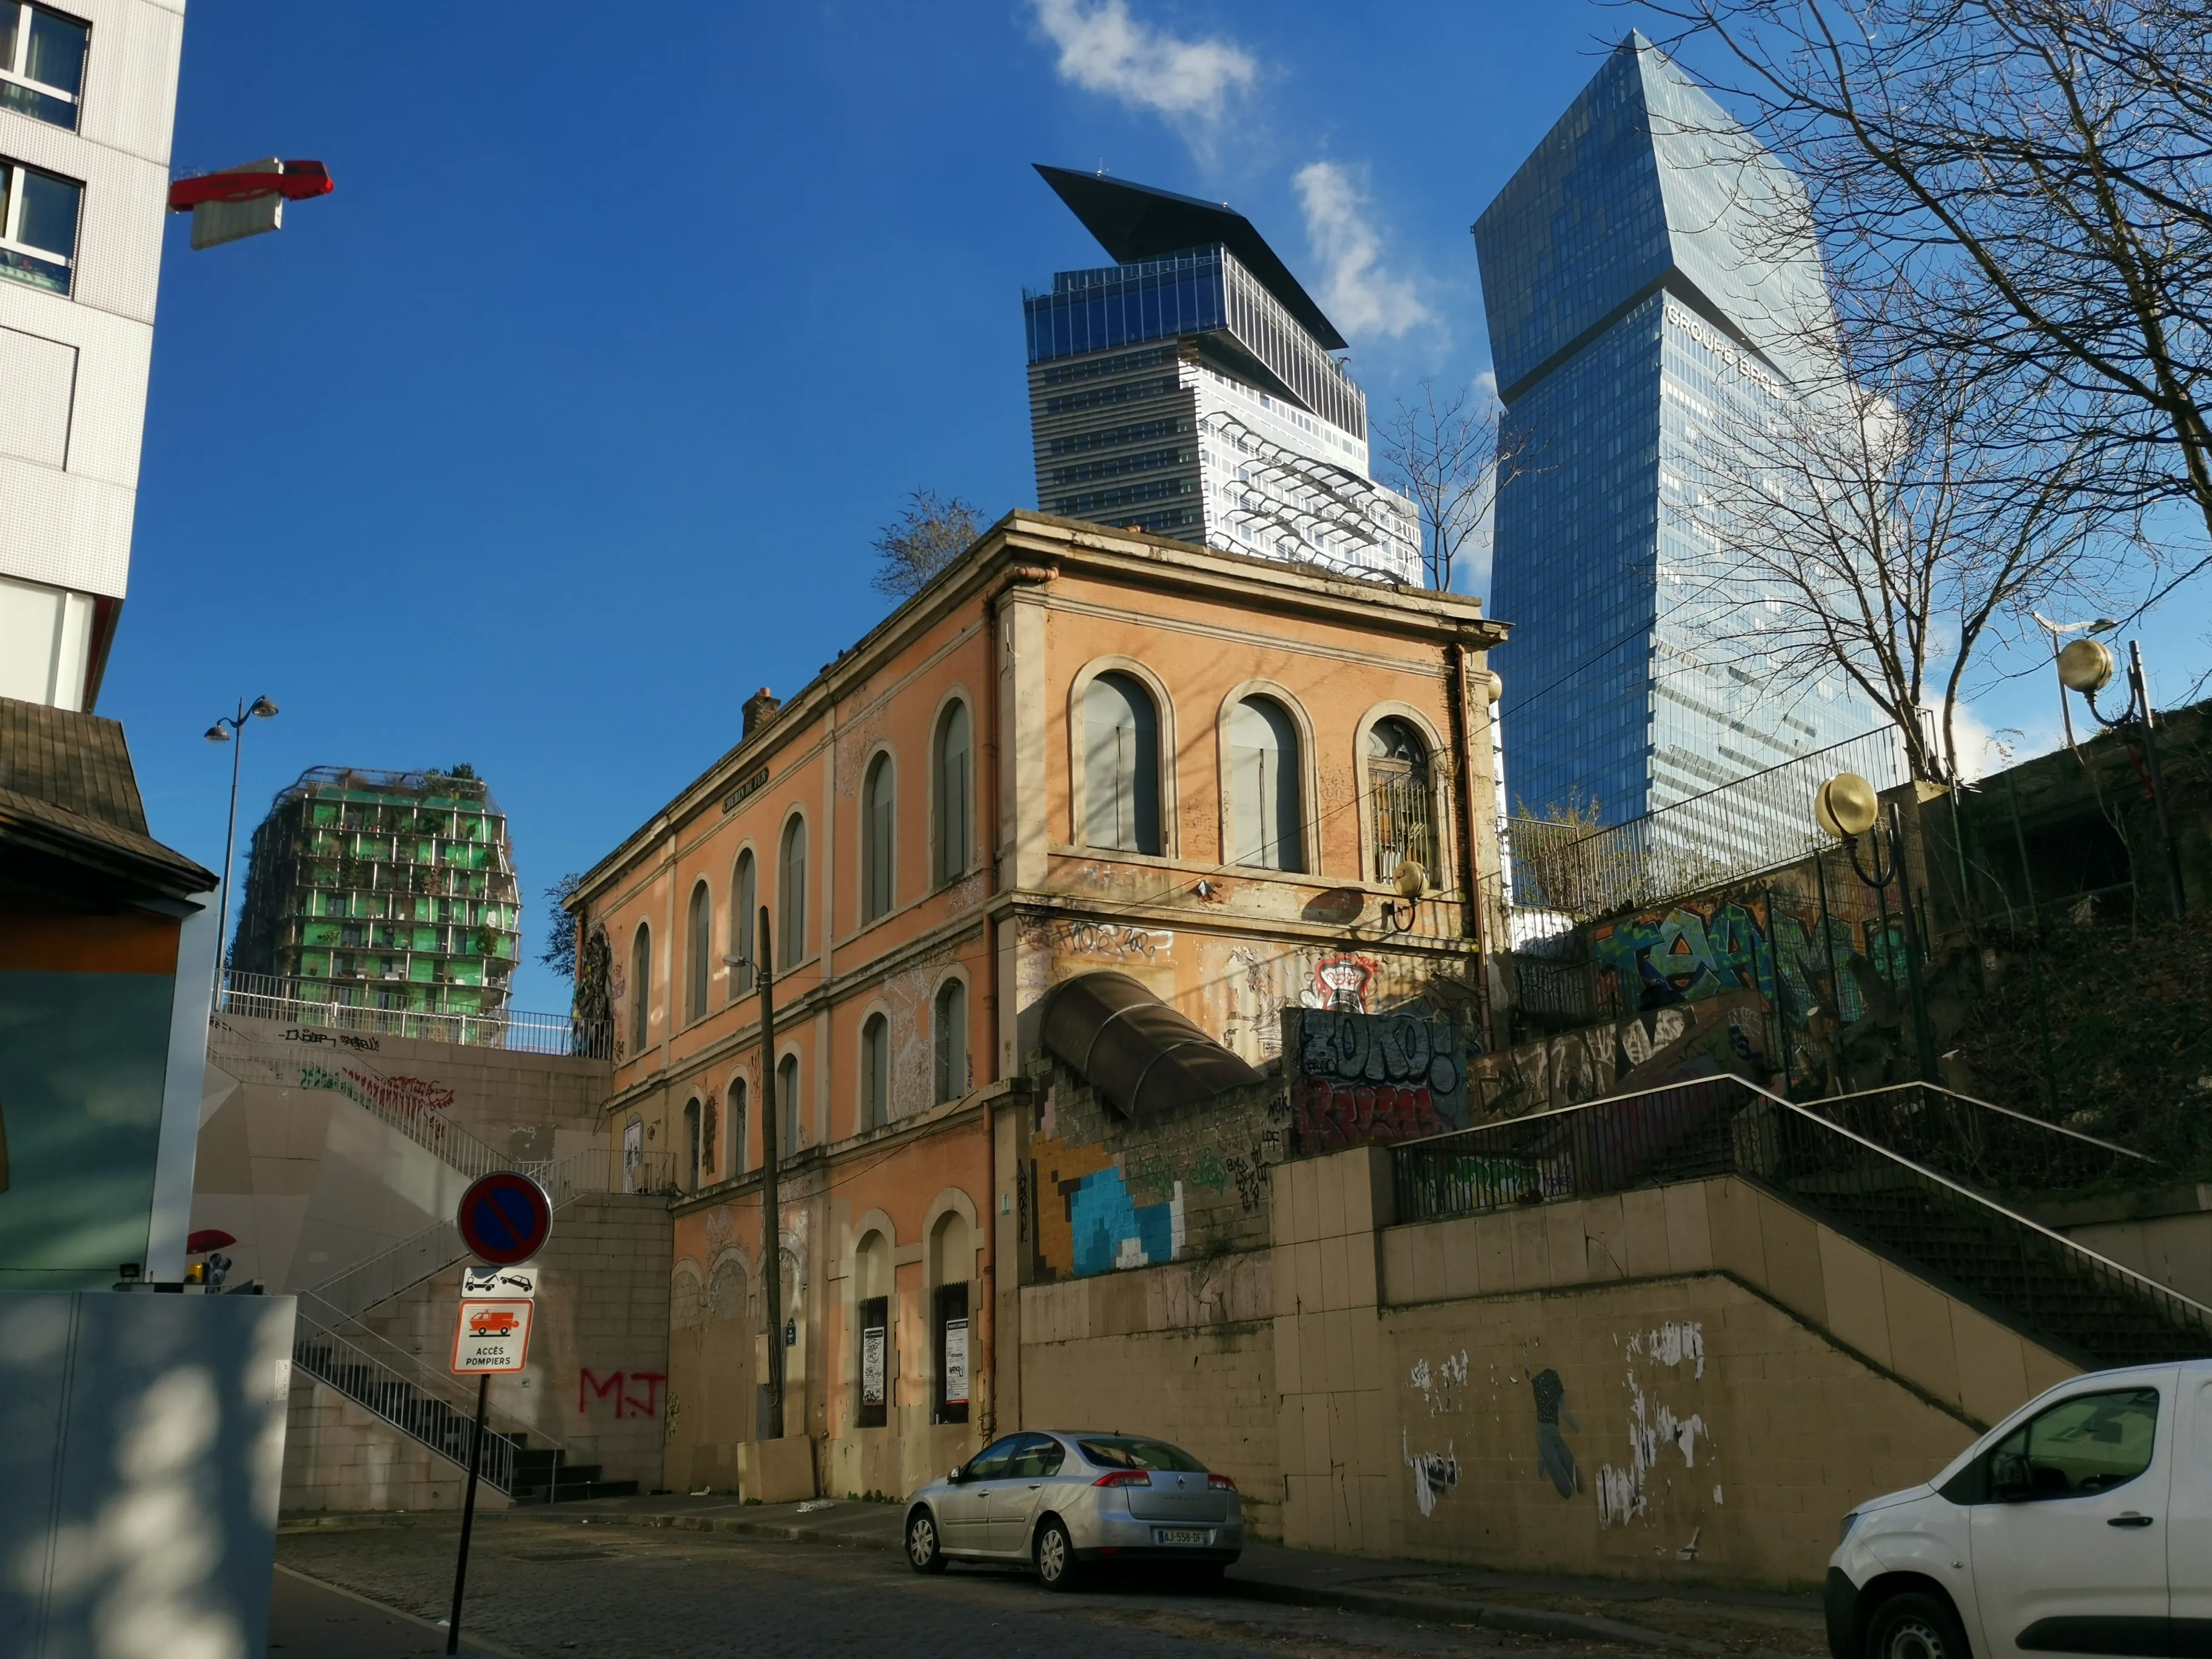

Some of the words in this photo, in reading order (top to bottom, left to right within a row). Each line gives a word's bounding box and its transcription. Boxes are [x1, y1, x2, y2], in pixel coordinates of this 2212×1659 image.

[1667, 304, 1735, 365] GROUPE
[723, 786, 745, 812] CHEMIN
[476, 1346, 504, 1355] ACCÈS
[466, 1357, 511, 1366] POMPIERS
